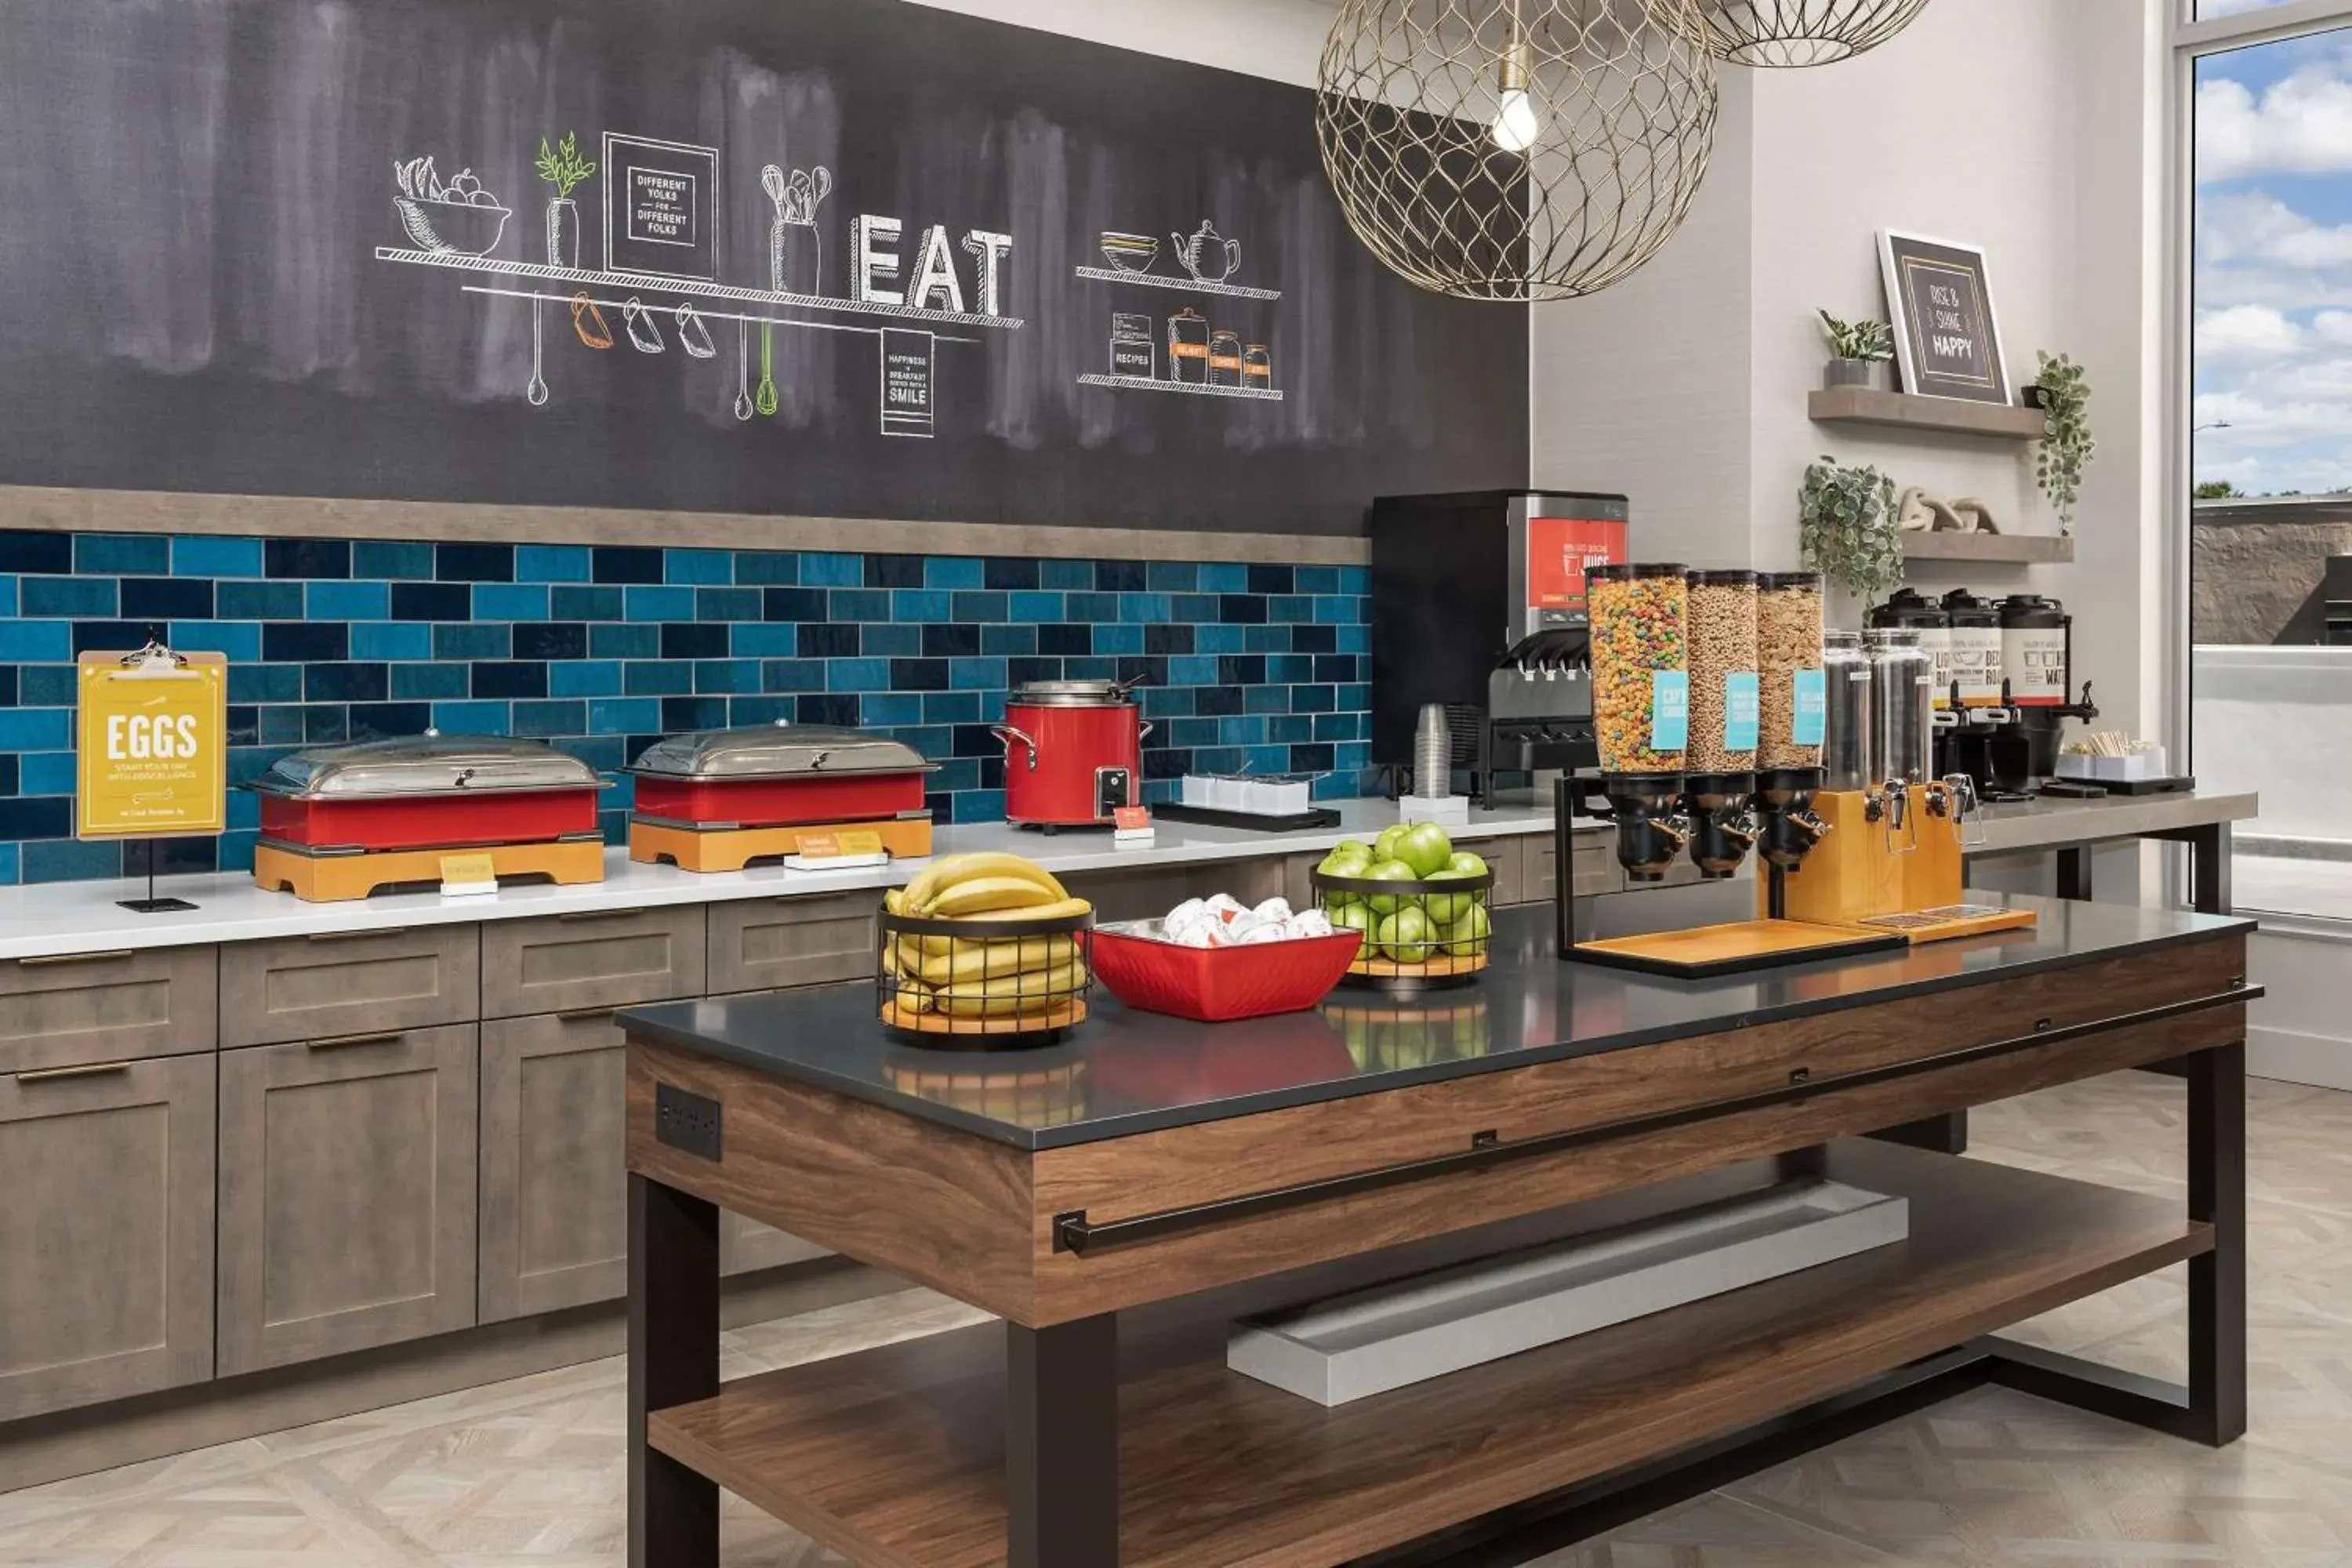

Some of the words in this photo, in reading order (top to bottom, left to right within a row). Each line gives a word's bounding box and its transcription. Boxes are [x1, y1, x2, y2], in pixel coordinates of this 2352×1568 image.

[637, 175, 687, 191] DIFFERENT
[648, 187, 677, 201] YOLKS
[637, 209, 687, 225] DIFFERENT
[648, 222, 677, 235] FOLKS
[850, 214, 1012, 315] EAT
[1933, 334, 1972, 360] HAPPY
[888, 354, 926, 365] HAPPINESS
[1116, 353, 1149, 365] RECIPES
[889, 387, 926, 405] SMILE
[107, 714, 197, 760] EGGS
